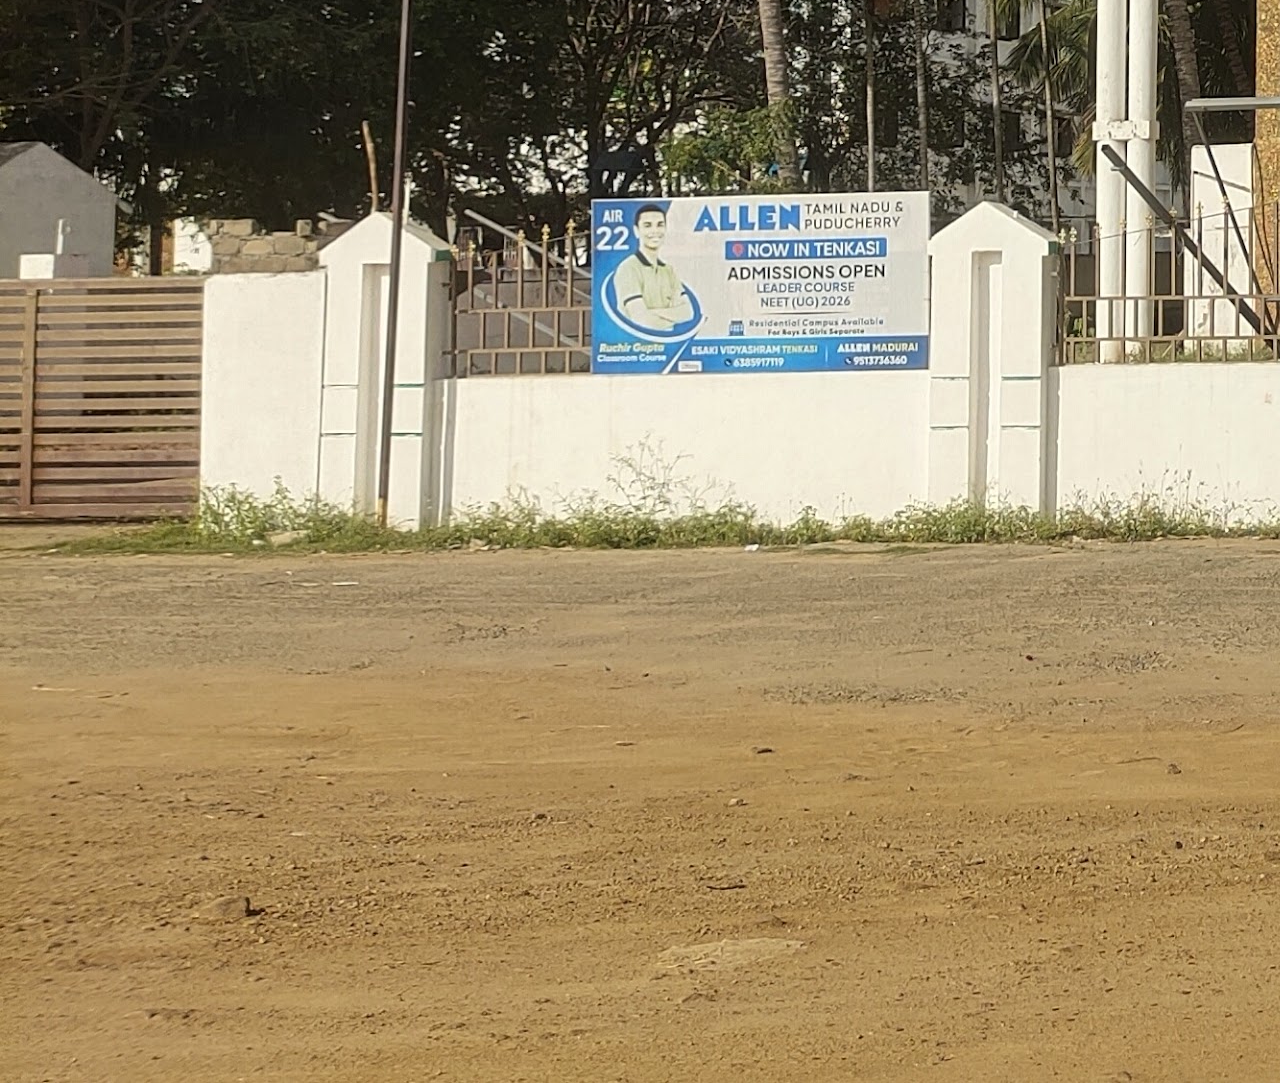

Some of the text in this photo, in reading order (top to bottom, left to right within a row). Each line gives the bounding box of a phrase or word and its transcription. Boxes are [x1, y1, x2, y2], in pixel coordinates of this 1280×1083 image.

[805, 201, 903, 215] TAMIL NADU &
[603, 209, 623, 224] AIR
[694, 204, 800, 232] ALLEN
[805, 216, 900, 230] PUDUCHERRY
[596, 225, 630, 251] 22
[747, 241, 880, 258] NOW IN TENKASI
[727, 264, 885, 281] ADMISSIONS OPEN
[757, 282, 855, 294] LEADER COURSE
[761, 296, 851, 309] NEET (UG) 2026
[749, 317, 884, 328] Residential Campus Available
[599, 342, 665, 354] Ruchir Gupta
[691, 344, 818, 355] ESAKI VIDYASHRAM TENKASI
[837, 342, 918, 353] ALLEN MADURAI
[639, 353, 667, 362] Course
